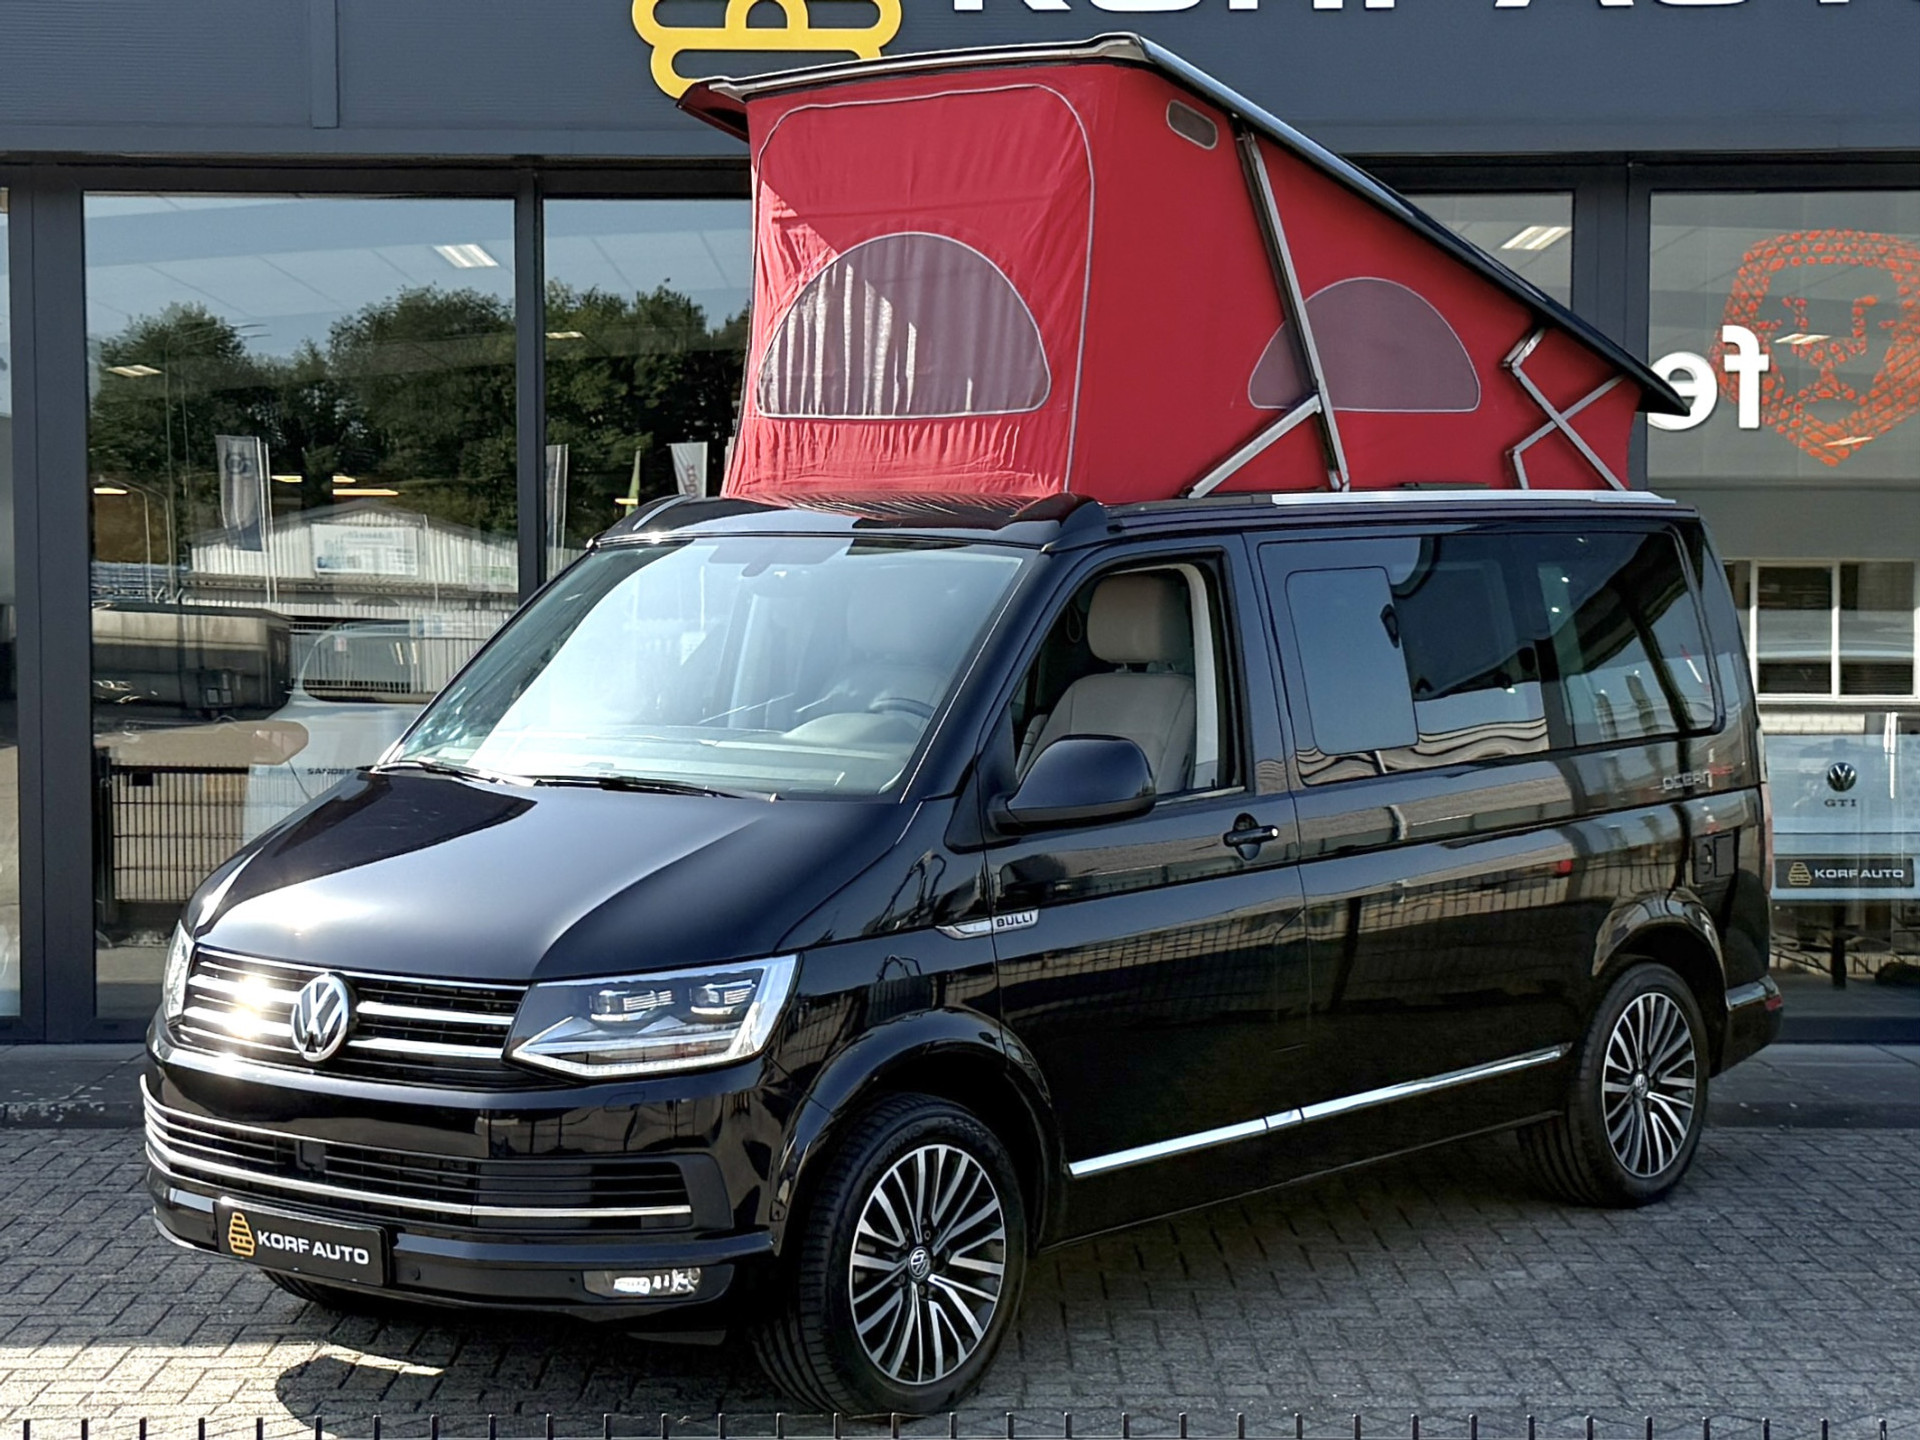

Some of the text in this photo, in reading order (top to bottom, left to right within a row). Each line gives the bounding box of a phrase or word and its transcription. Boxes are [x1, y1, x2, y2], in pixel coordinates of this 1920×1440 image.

[1824, 799, 1857, 807] GTI
[1814, 869, 1905, 879] KORF AUTO
[997, 913, 1033, 927] BULLI
[257, 1230, 370, 1265] KORF AUTO
